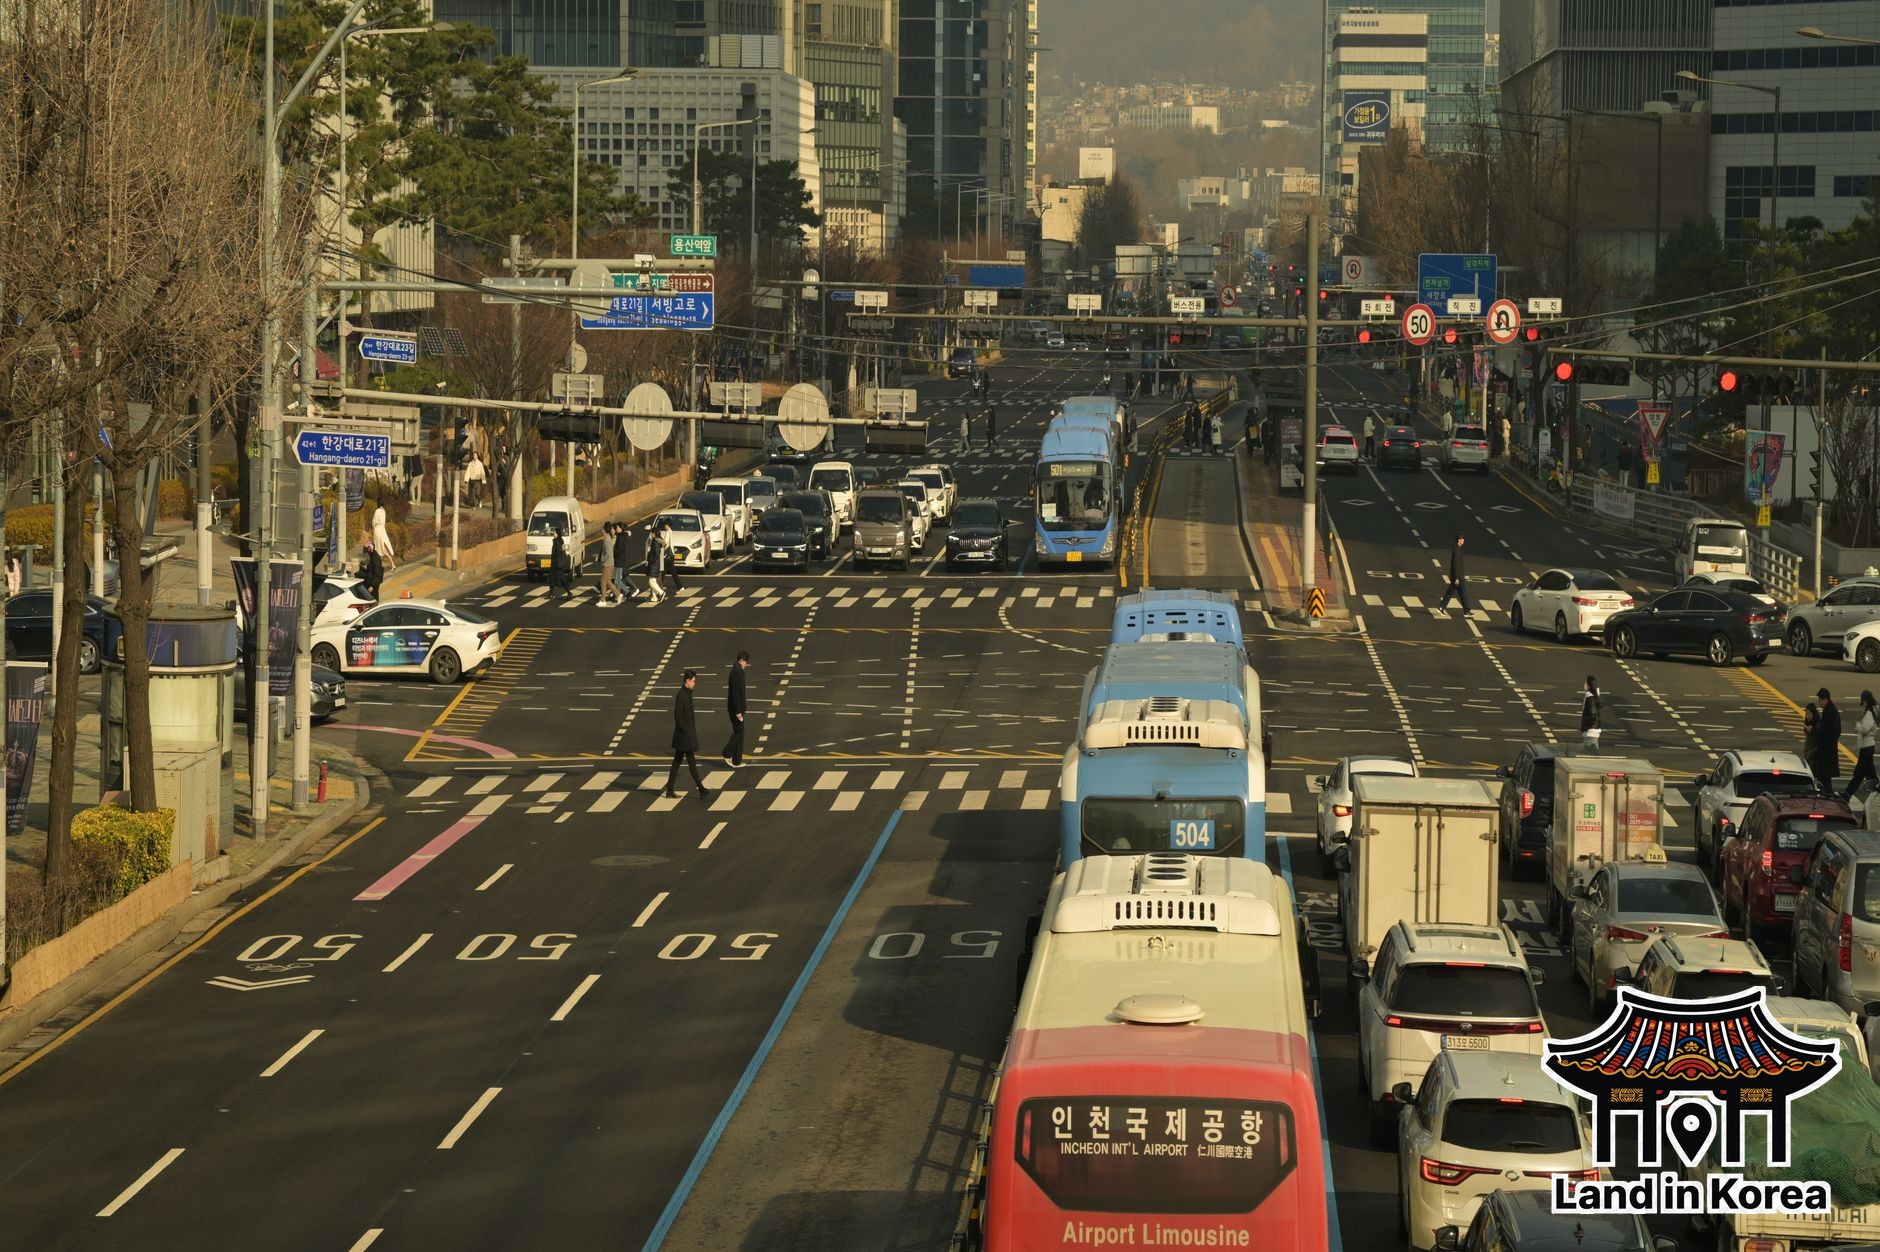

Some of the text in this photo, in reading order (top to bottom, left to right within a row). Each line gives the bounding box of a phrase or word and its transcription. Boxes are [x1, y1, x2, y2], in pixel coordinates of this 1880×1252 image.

[674, 238, 712, 253] 용산역앞
[1465, 259, 1489, 269] 삼각지역
[651, 297, 696, 313] 서빙고로
[1173, 300, 1203, 310] 버스전용
[1410, 314, 1428, 335] 50
[375, 340, 415, 354] 한강대로23길
[321, 435, 387, 454] 한강대로21길
[309, 451, 387, 467] Hangang-daero 21-gil
[1366, 569, 1425, 579] 50
[1462, 574, 1523, 585] 50
[1175, 822, 1210, 847] 504
[1649, 853, 1664, 861] TAXI
[236, 933, 364, 962] 50
[455, 933, 578, 961] 50
[657, 932, 780, 961] 50
[867, 929, 1003, 960] 50
[1051, 1105, 1263, 1145] 인천국제공항
[1060, 1141, 1253, 1160] INCHEON INT'L AIRPORT 仁川國際空港
[1062, 1220, 1251, 1247] Airport Limousine
